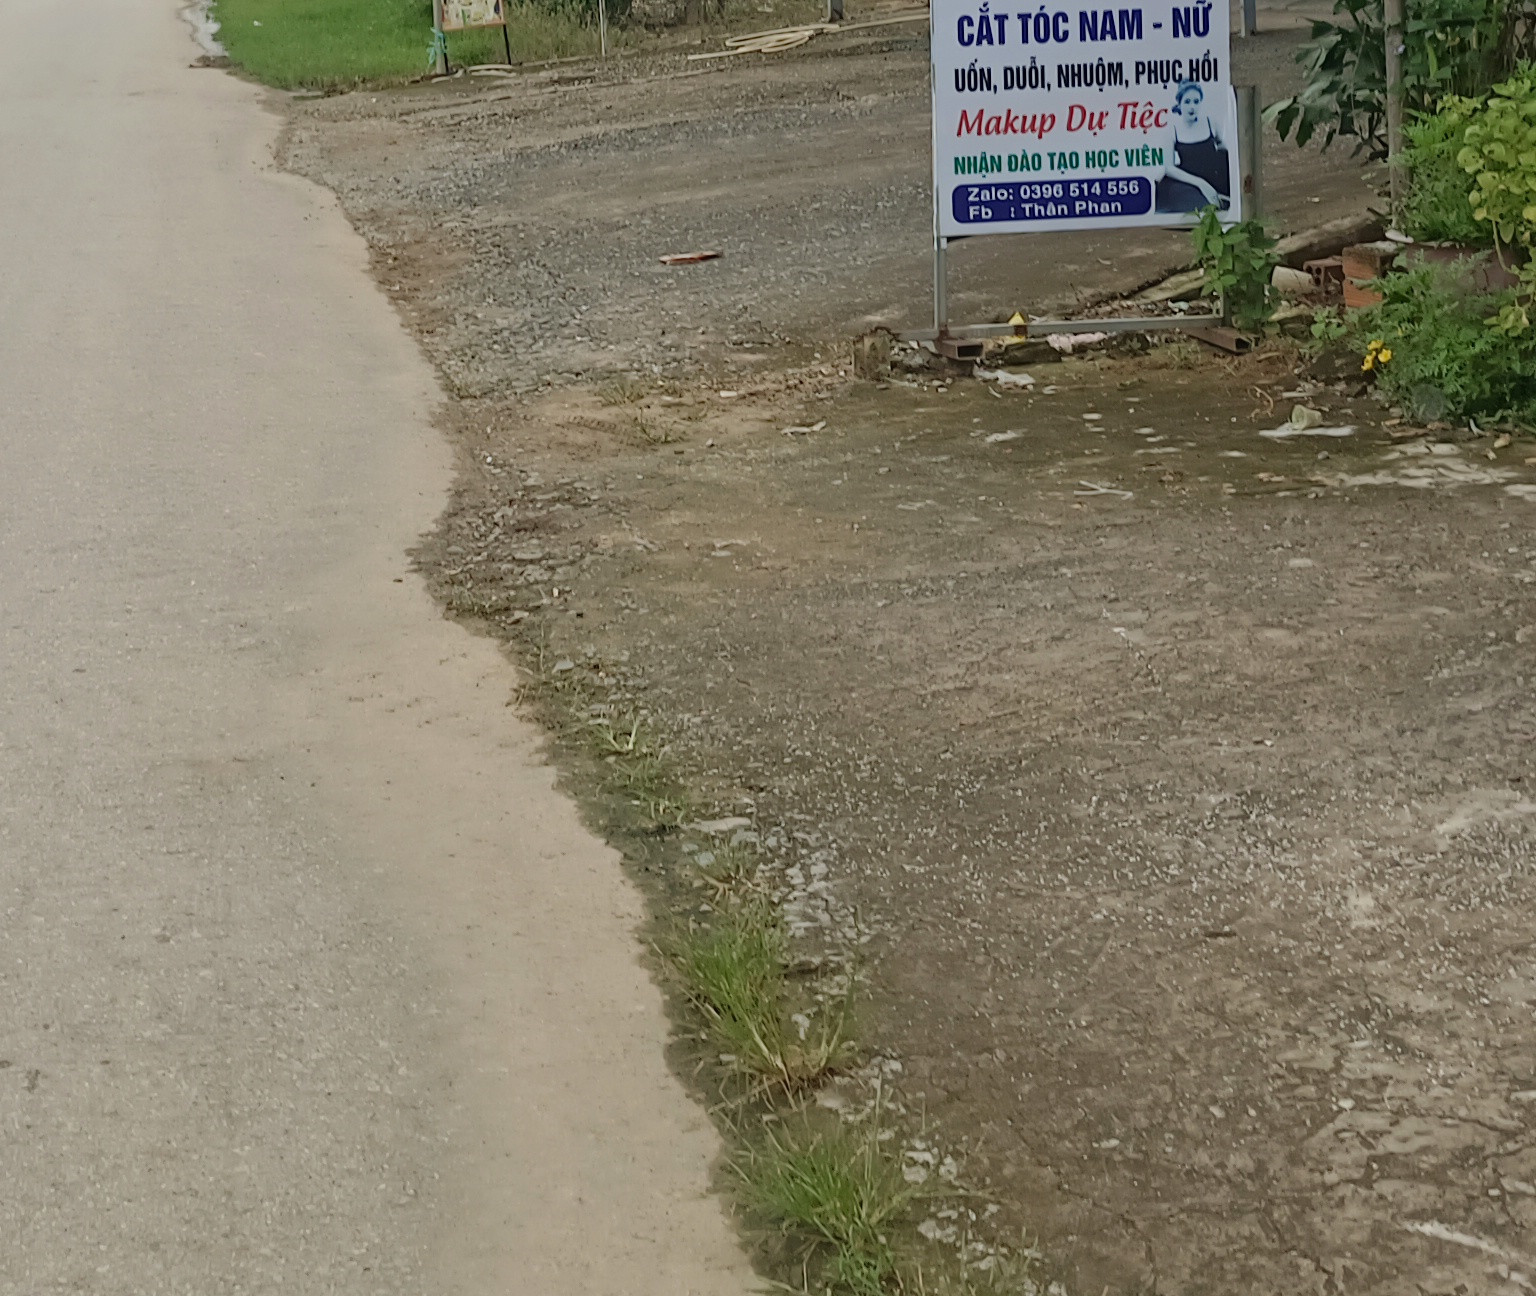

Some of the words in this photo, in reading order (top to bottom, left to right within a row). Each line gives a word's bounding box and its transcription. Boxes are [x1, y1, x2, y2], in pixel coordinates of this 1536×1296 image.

[957, 2, 1009, 47] CẮT
[1017, 5, 1069, 44] TÓC
[1078, 9, 1143, 42] NAM
[1171, 0, 1213, 38] NỮ
[954, 58, 998, 94] UỐN,
[1003, 55, 1051, 92] DUỖI,
[1057, 57, 1129, 92] NHUỘM,
[1135, 59, 1183, 90] PHỤC
[956, 108, 1057, 140] Makup
[1066, 104, 1109, 136] Dự
[1117, 101, 1169, 134] Tiệc
[954, 151, 1002, 178] NHẬN
[1007, 149, 1042, 172] ĐÀO
[1048, 151, 1080, 175] TẠO
[1085, 149, 1120, 173] HỌC
[1124, 143, 1164, 167] VIÊN
[967, 186, 1014, 202] Zalo:
[1020, 184, 1064, 200] 0396
[1069, 182, 1102, 197] 514
[1107, 180, 1140, 195] 556
[968, 205, 993, 221] Fb
[1075, 200, 1123, 215] Phan
